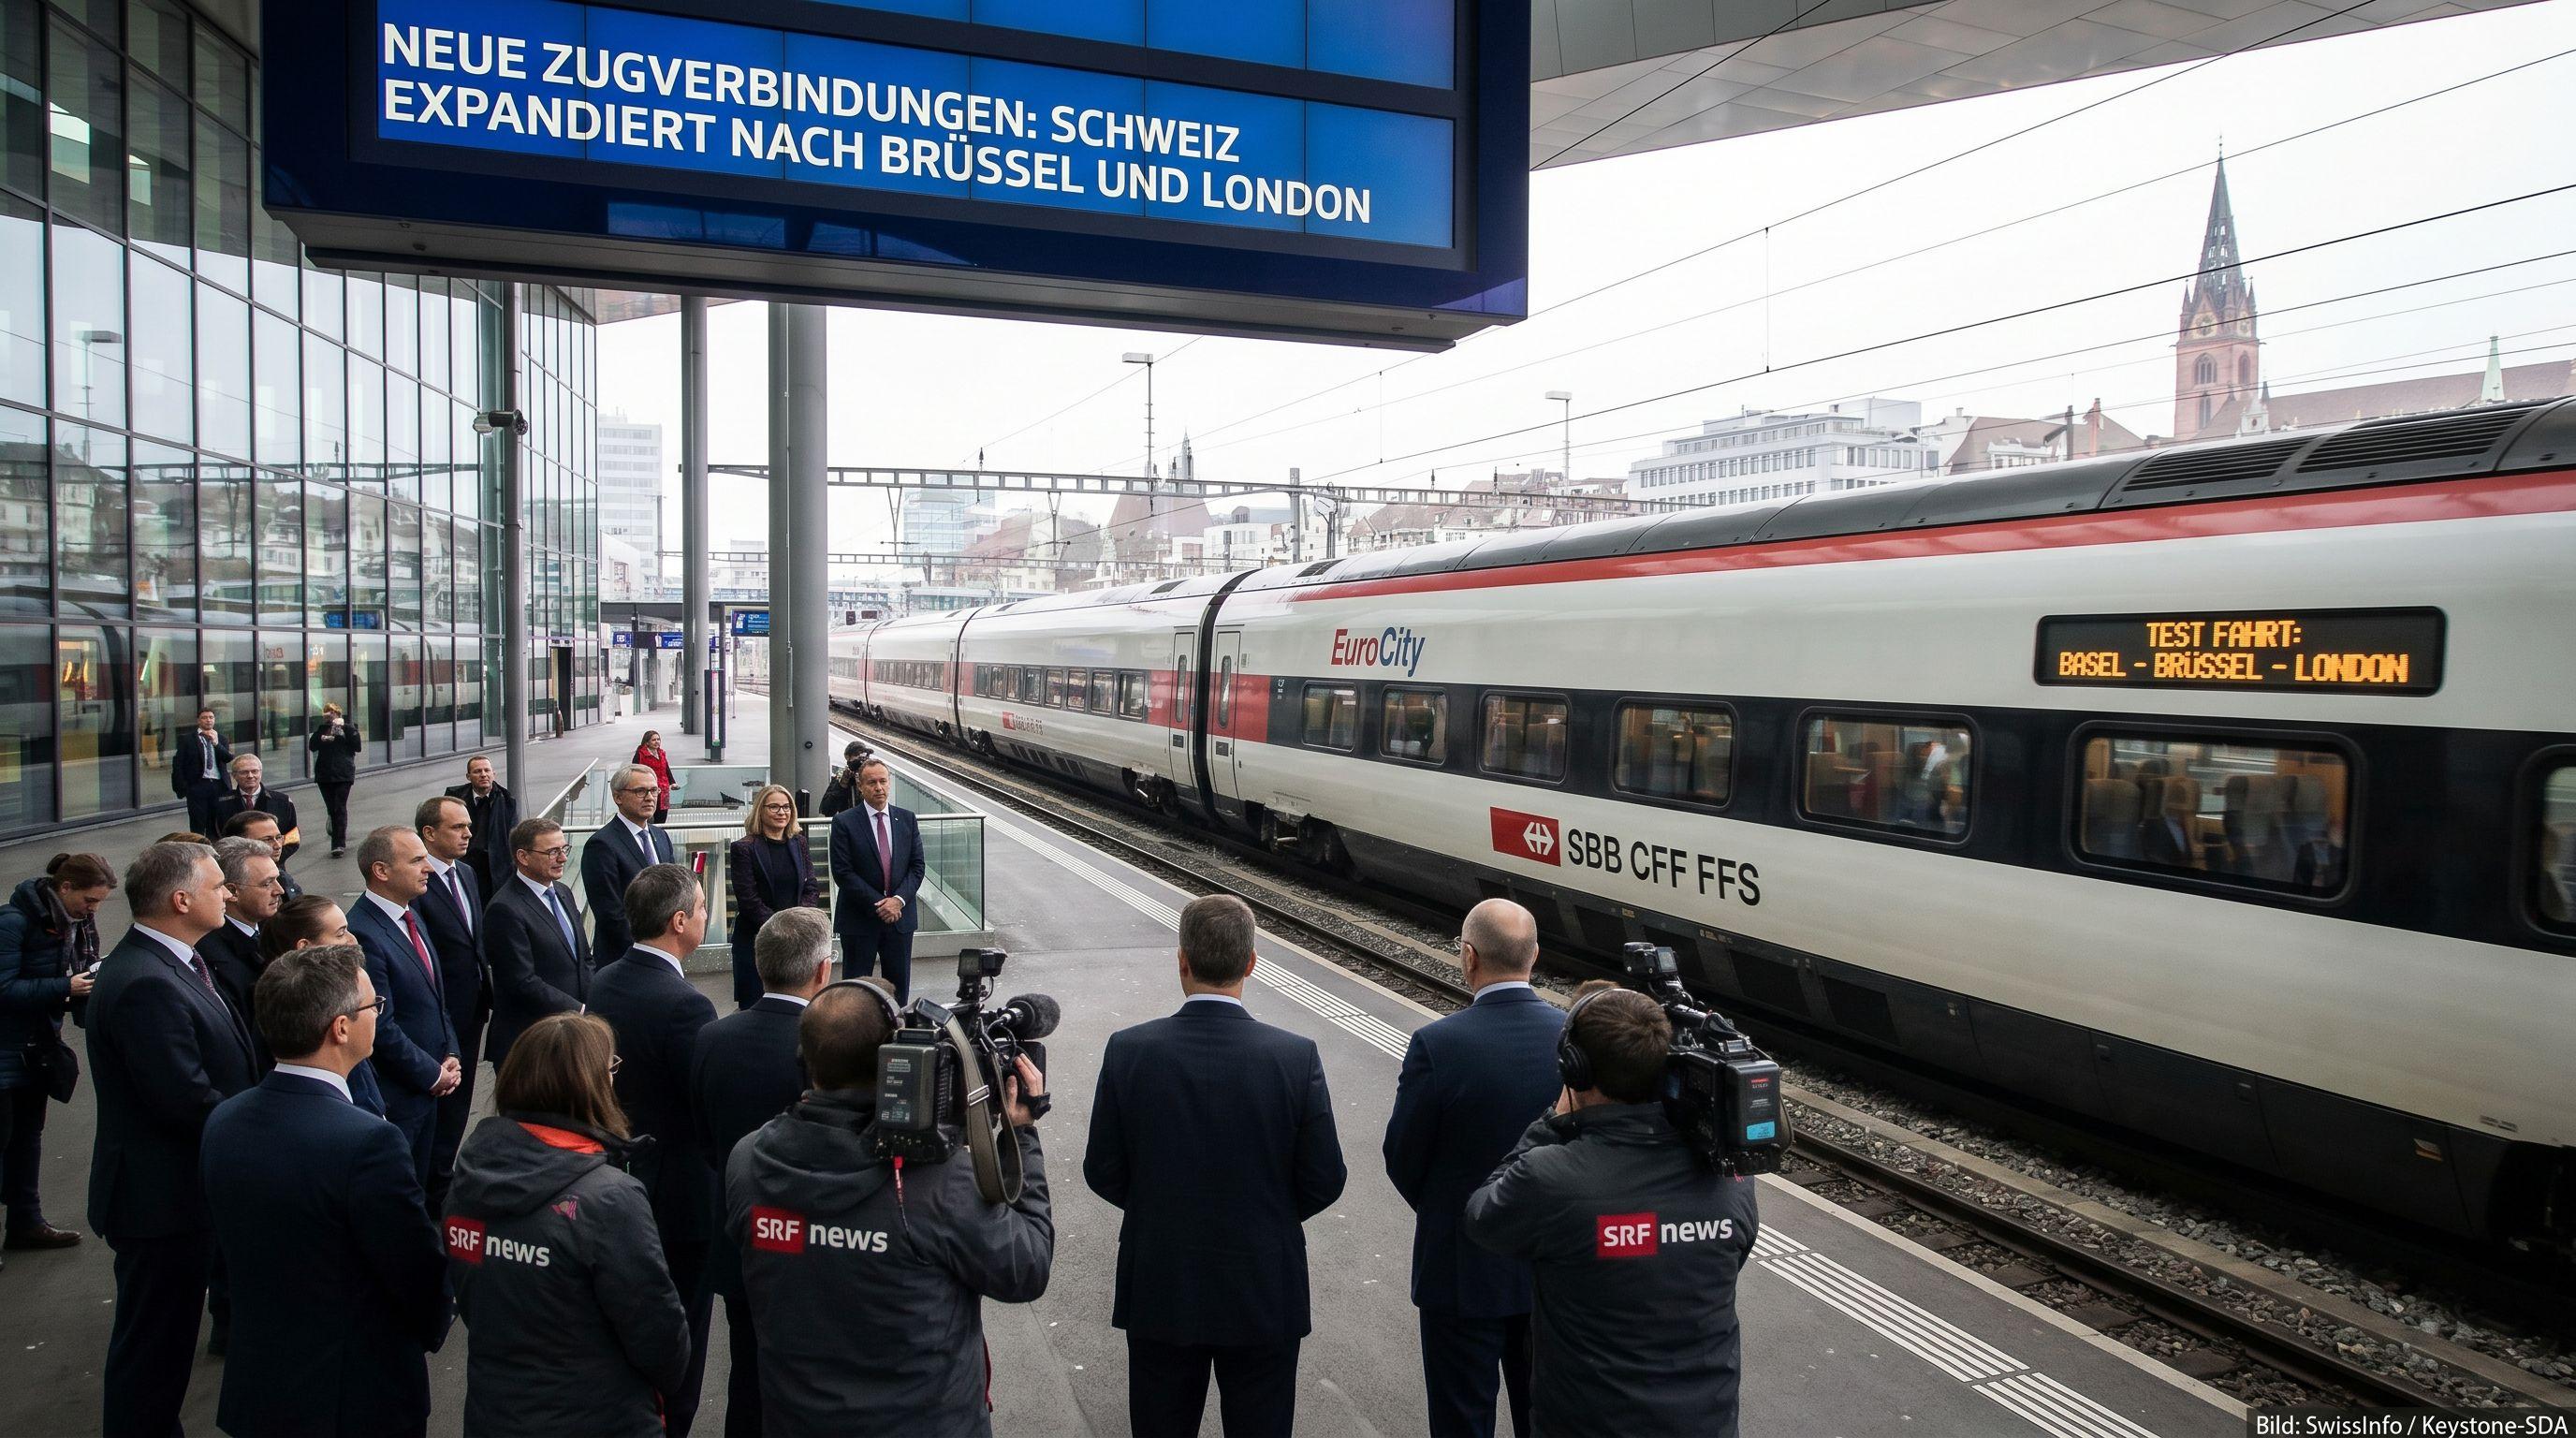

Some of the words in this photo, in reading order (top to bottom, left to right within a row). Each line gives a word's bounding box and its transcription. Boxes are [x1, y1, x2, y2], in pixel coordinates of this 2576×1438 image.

[384, 22, 527, 80] NEUE
[542, 42, 1037, 139] ZUGVERBINDUNGEN:
[1051, 105, 1239, 163] SCHWEIZ
[385, 78, 716, 154] EXPANDIERT
[732, 117, 864, 170] NACH
[881, 132, 1085, 194] BRÜSSEL
[1098, 159, 1189, 203] UND
[1203, 171, 1370, 224] LONDON
[1330, 626, 1426, 677] EuroCity
[2146, 622, 2206, 648] TEST
[2212, 620, 2302, 648] FAHRT:
[2058, 652, 2127, 677] BASEL
[2153, 651, 2263, 681] BRÜSSEL
[2294, 653, 2409, 683] LONDON
[1567, 828, 1623, 874] SBB
[1630, 841, 1688, 888] CFF
[1697, 853, 1761, 906] FFS
[448, 1225, 480, 1251] SRF
[485, 1235, 550, 1268] news
[756, 1216, 800, 1242] SRF
[810, 1224, 888, 1254] news
[1603, 1222, 1651, 1247] SRF
[1661, 1218, 1733, 1244] news
